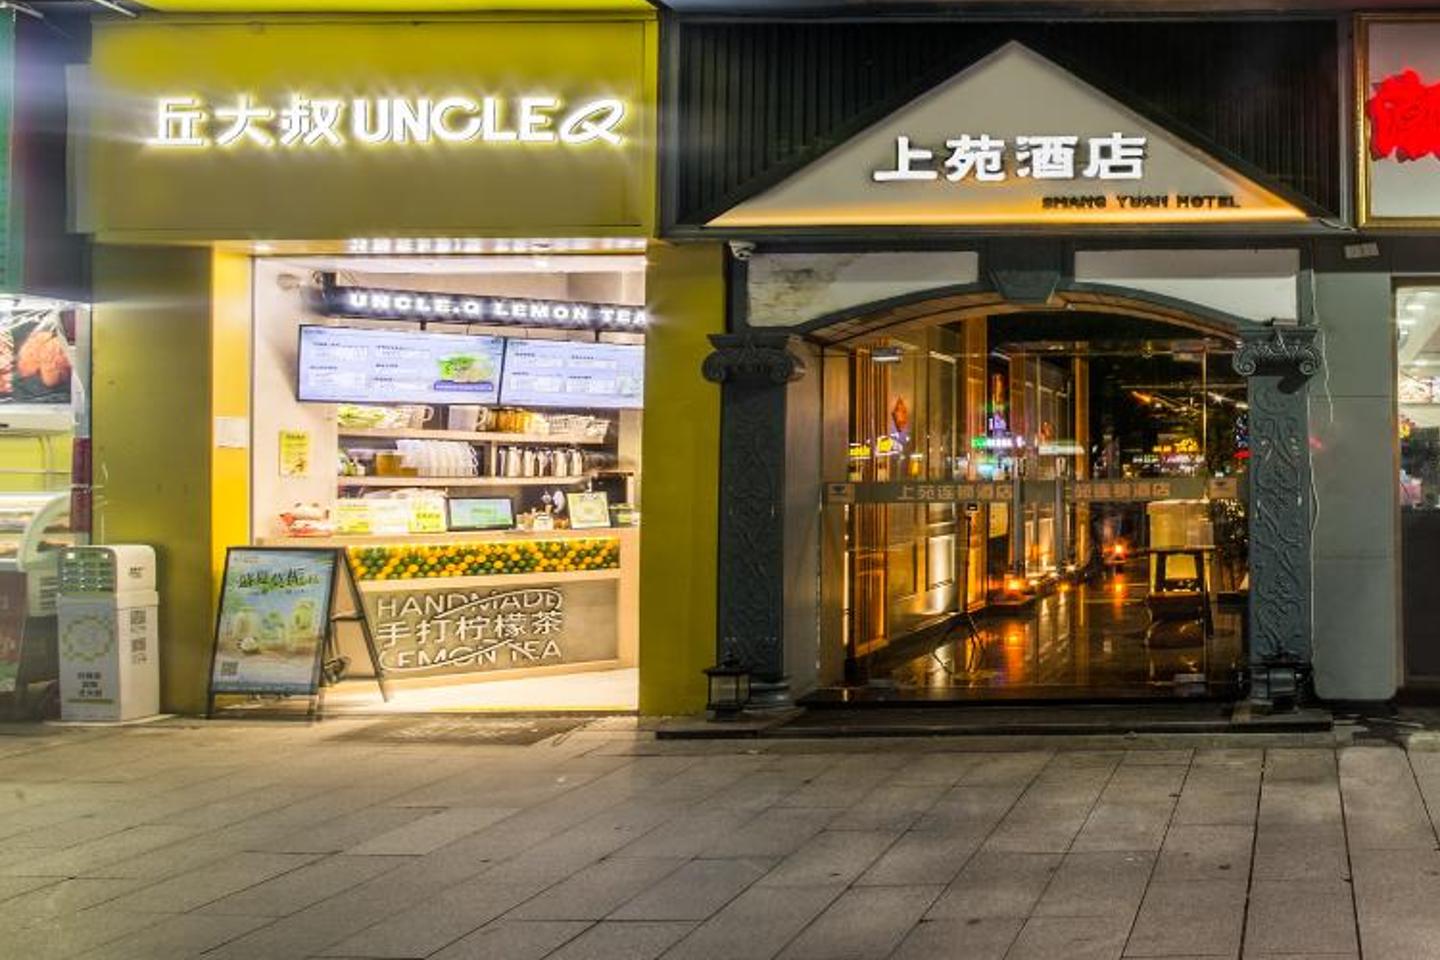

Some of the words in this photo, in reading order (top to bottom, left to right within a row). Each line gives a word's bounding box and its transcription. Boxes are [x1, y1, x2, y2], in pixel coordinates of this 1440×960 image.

[146, 96, 342, 147] 丘大叔
[872, 132, 1148, 182] 上苑酒店
[1042, 195, 1107, 209] SHANG
[1116, 195, 1169, 209] YUAN
[1176, 195, 1241, 209] HOTEL
[493, 301, 589, 320] LEMON
[600, 309, 647, 326] TEA
[377, 610, 562, 649] 手打柠檬茶
